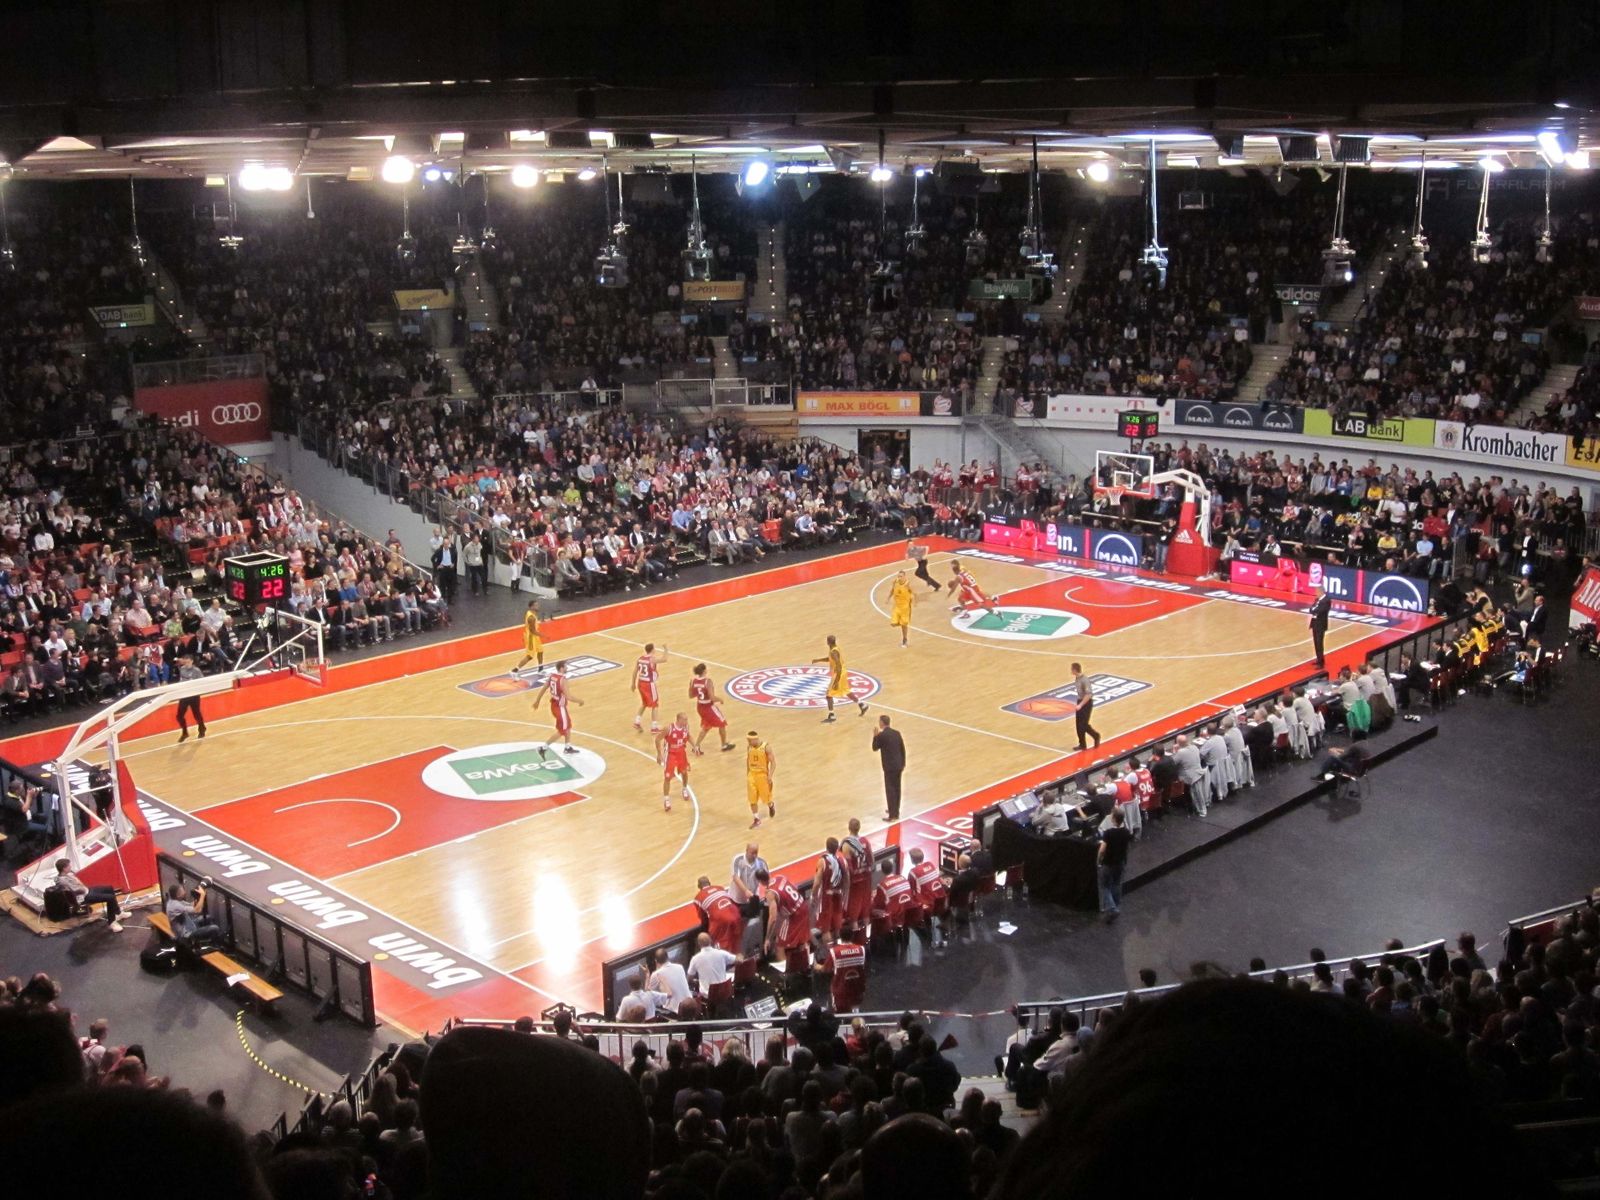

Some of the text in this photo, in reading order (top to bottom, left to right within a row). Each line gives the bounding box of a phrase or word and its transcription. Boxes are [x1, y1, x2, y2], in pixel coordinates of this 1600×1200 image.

[1457, 179, 1566, 190] FLYERALARM
[826, 401, 891, 411] MAX BÖGL
[1125, 424, 1139, 437] 22
[1266, 421, 1290, 429] MAN
[1462, 427, 1558, 462] Krombacher
[1099, 551, 1134, 565] MAN
[260, 564, 284, 577] 4:26
[232, 581, 245, 600] 22
[262, 578, 284, 599] 22
[1114, 575, 1191, 591] bwin
[1204, 590, 1287, 608] bwin
[1373, 595, 1418, 611] MAN
[735, 668, 829, 695] MÜNCHEN
[697, 687, 705, 700] 5
[464, 759, 566, 781] BayWa
[181, 834, 271, 878] bwin
[785, 885, 799, 901] 8
[267, 880, 369, 929] bwin
[368, 931, 484, 989] bwin
